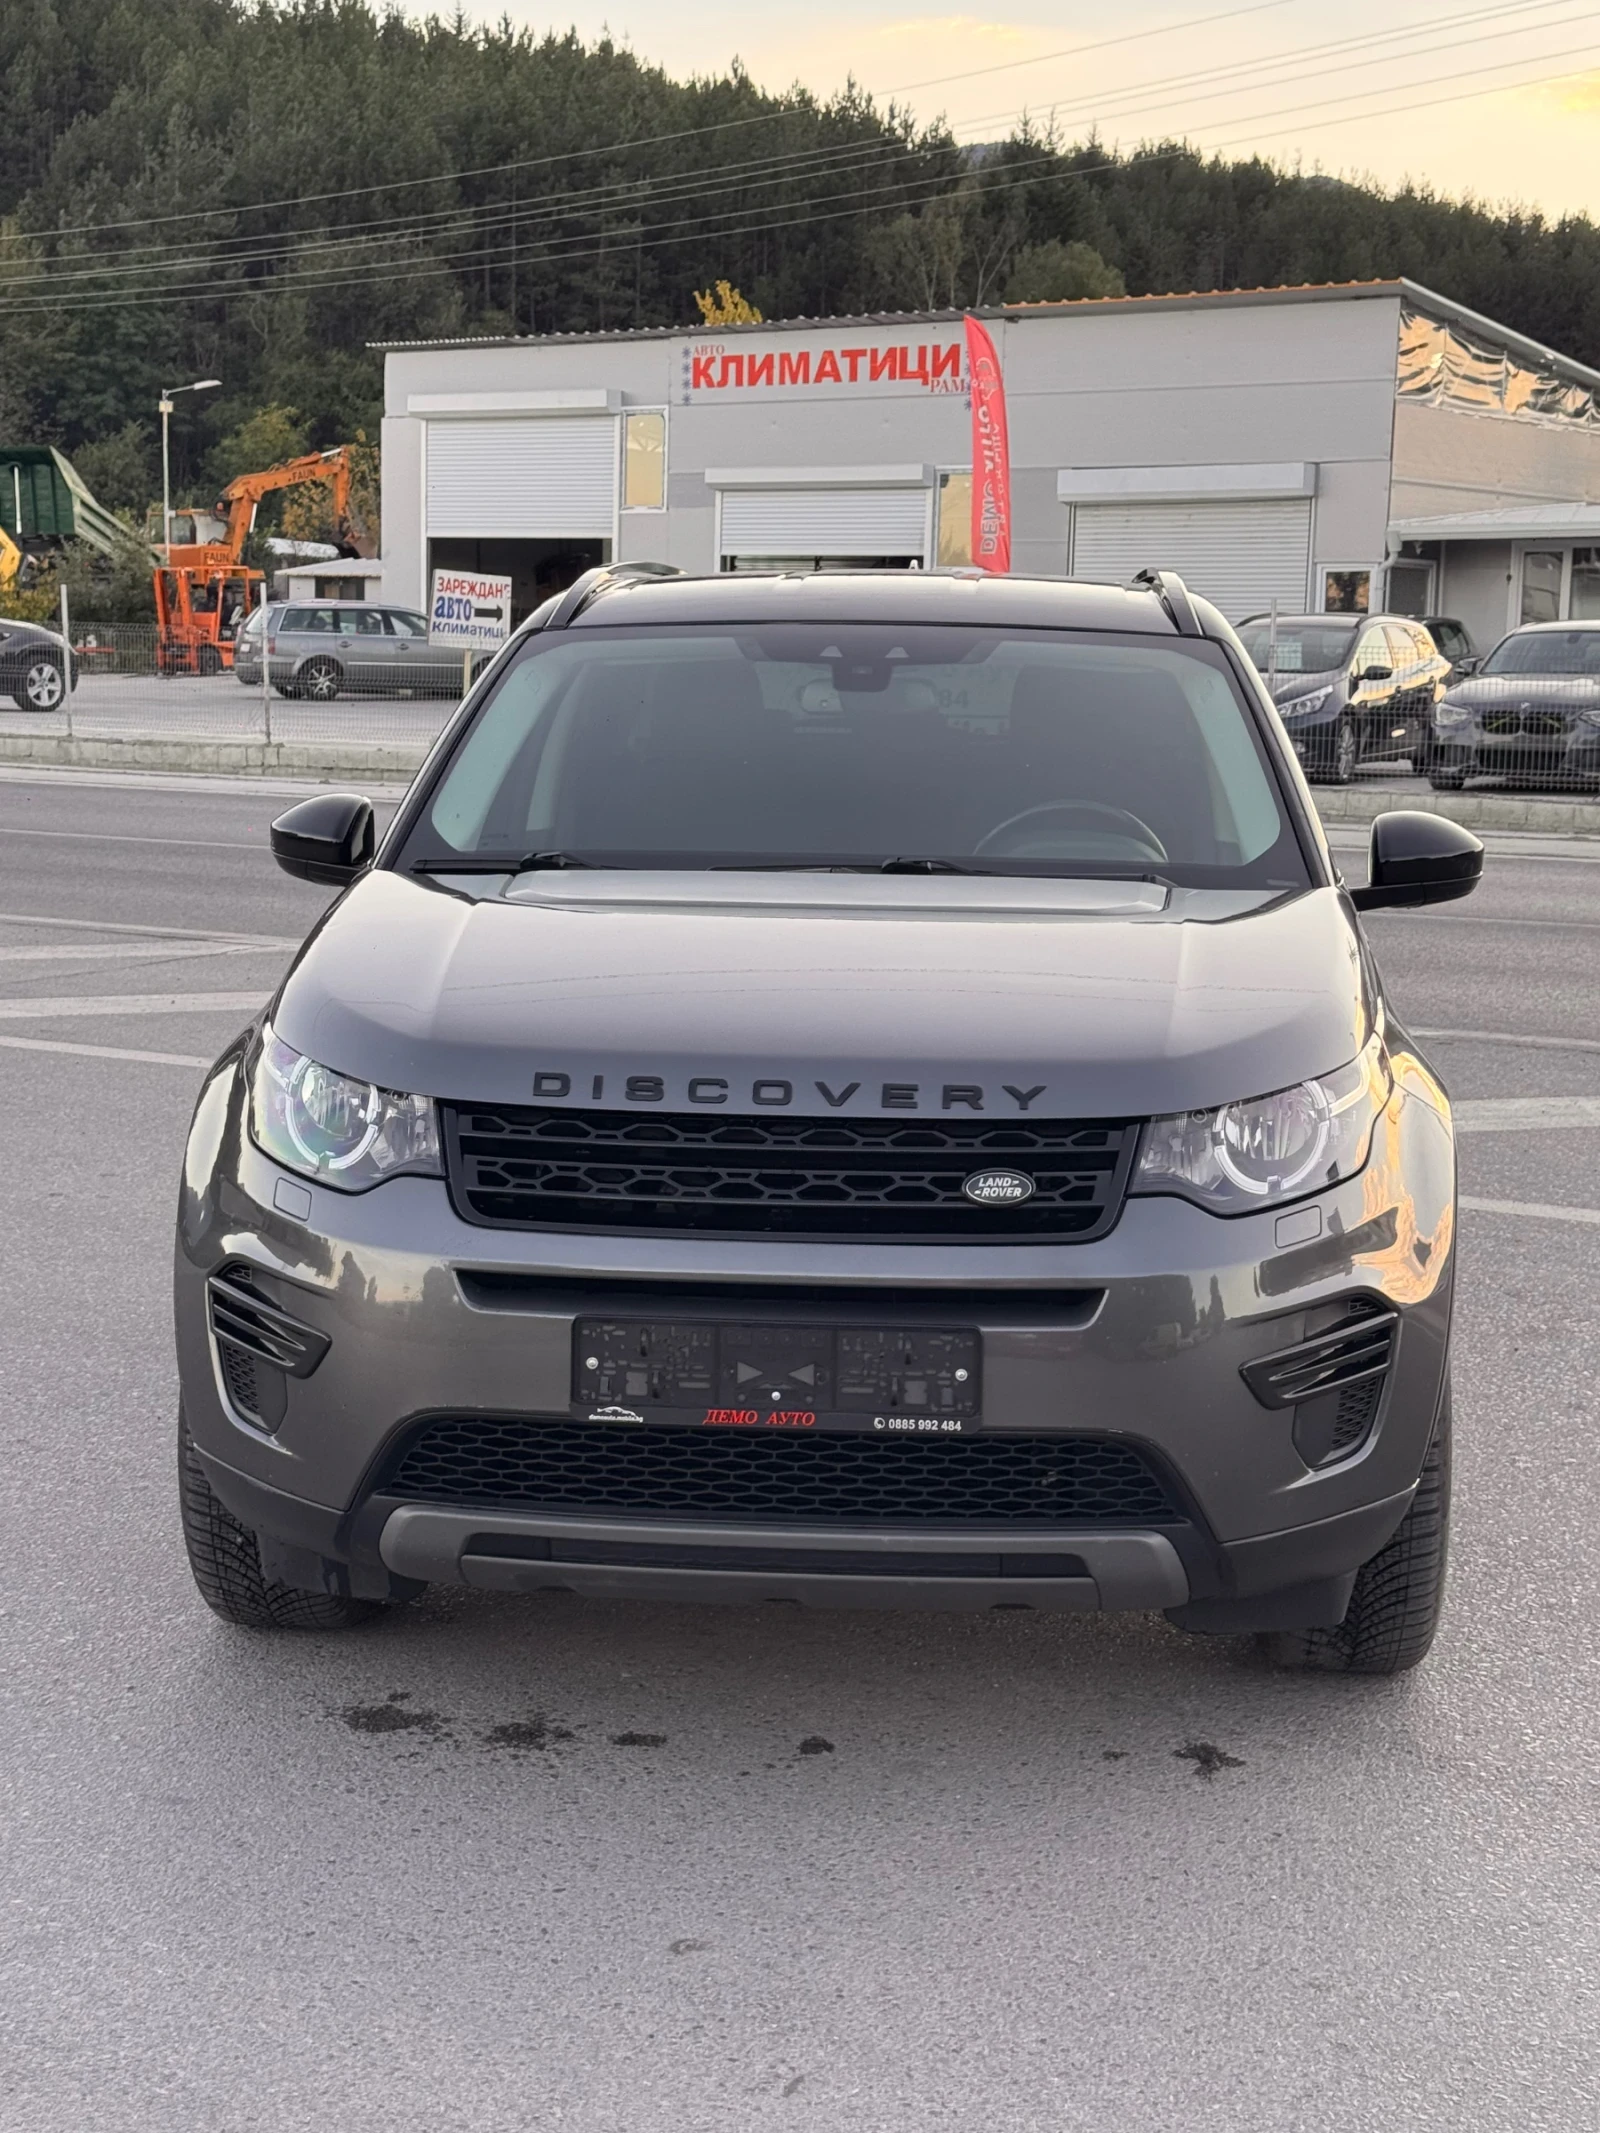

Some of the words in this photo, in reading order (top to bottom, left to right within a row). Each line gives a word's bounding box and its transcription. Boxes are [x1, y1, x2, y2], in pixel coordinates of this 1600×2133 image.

[692, 344, 725, 356] АВТО
[692, 343, 961, 389] КЛИМАТИЦИ
[292, 468, 317, 481] FAUN
[204, 552, 230, 564] FAUN
[533, 1071, 1047, 1111] DISCOVERY
[703, 1408, 758, 1425] ДЕМО
[765, 1411, 816, 1426] АУТО
[888, 1418, 915, 1430] 0885
[918, 1419, 939, 1431] 992
[940, 1420, 962, 1431] 484
